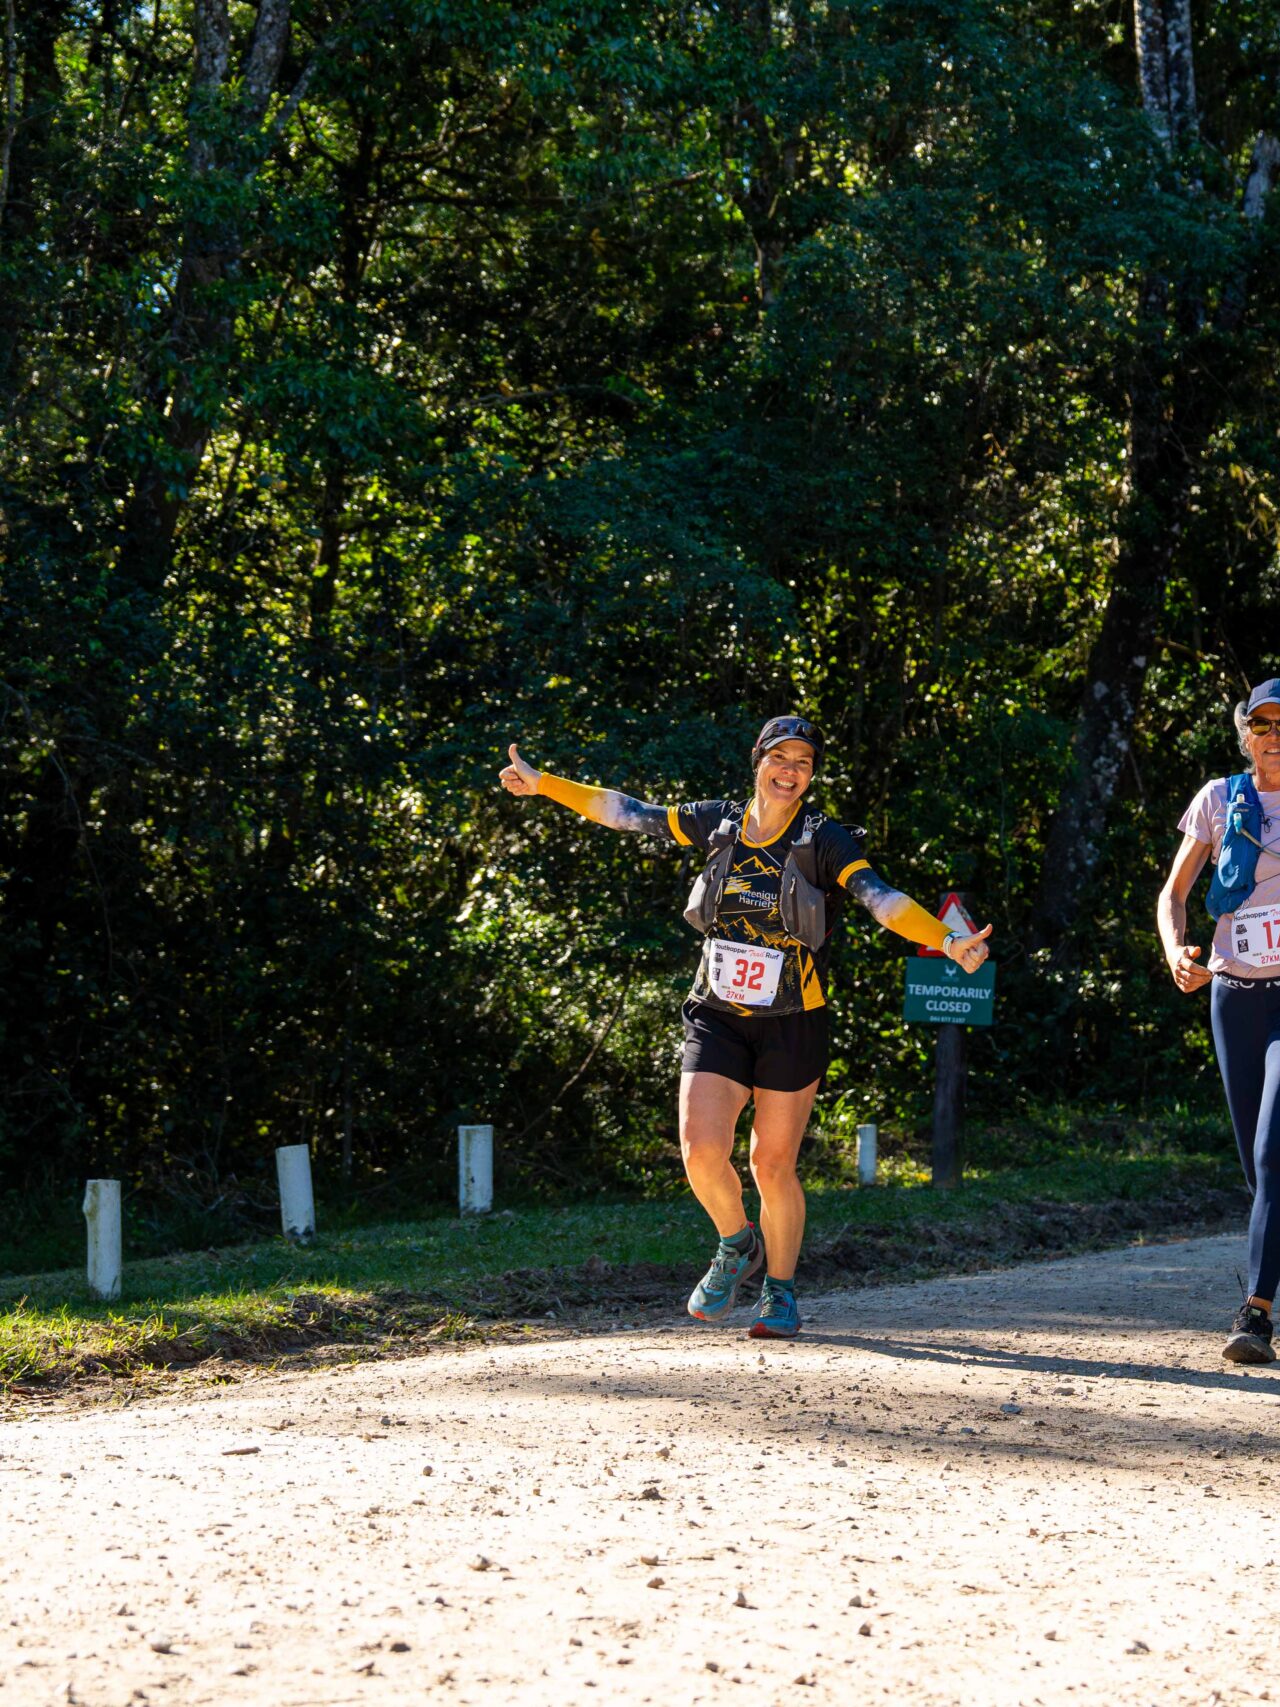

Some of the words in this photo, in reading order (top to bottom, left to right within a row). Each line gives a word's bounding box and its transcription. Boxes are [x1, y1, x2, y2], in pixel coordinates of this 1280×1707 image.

[765, 952, 779, 960] Run
[1261, 955, 1280, 965] 27KM
[732, 958, 766, 991] 32
[725, 991, 745, 1001] 27KM
[907, 984, 991, 999] TEMPORARILY
[925, 1000, 971, 1013] CLOSED
